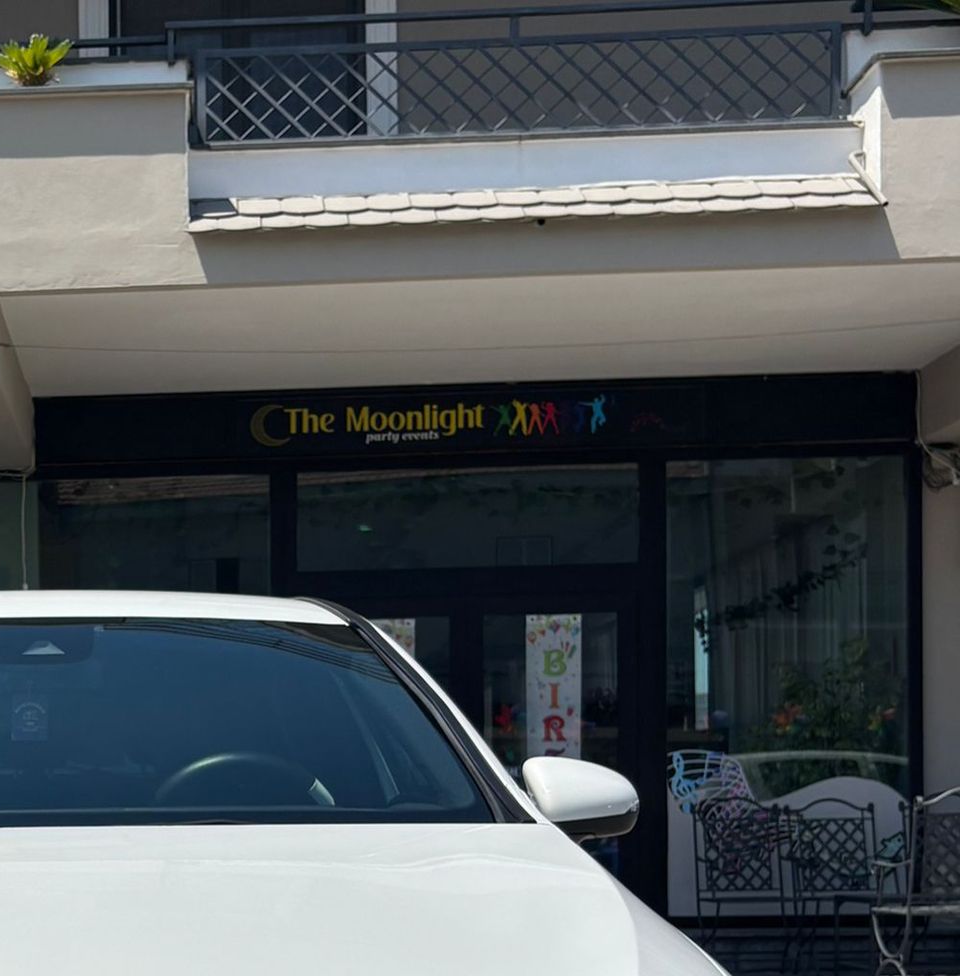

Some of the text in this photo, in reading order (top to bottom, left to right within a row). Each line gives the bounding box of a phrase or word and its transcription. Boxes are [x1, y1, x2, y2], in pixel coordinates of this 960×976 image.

[282, 402, 486, 437] The Moonlight
[365, 429, 440, 445] party events
[542, 649, 567, 757] BIR
